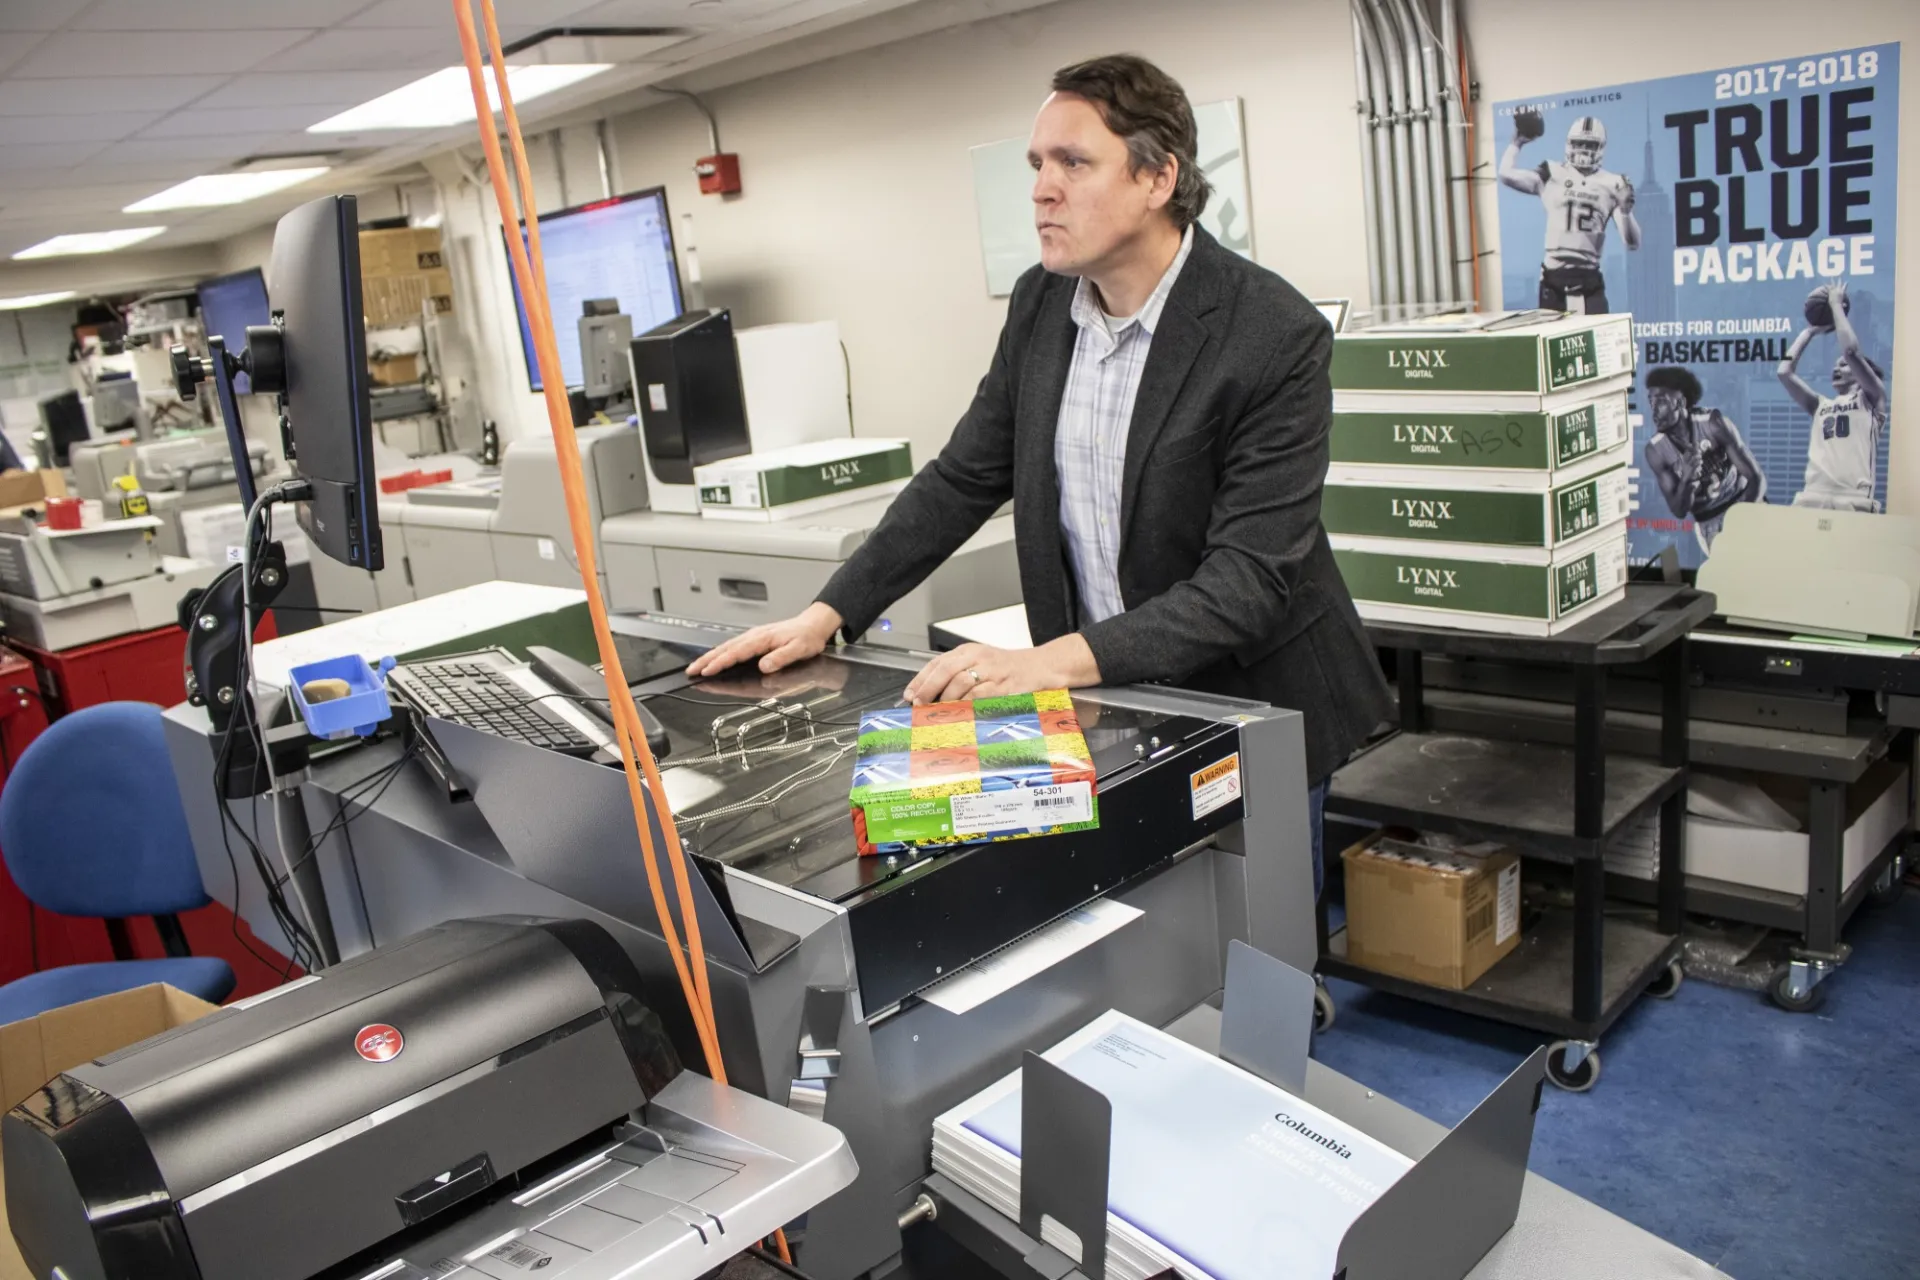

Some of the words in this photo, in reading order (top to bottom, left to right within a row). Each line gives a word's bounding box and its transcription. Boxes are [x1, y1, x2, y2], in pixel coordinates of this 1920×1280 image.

[1715, 51, 1878, 99] 2017-2018
[1498, 101, 1556, 116] COLUMBIA
[1563, 92, 1622, 108] ATHLETICS
[1664, 86, 1874, 178] TRUE
[1674, 162, 1873, 247] BLUE
[1563, 200, 1593, 232] 12
[1673, 235, 1875, 285] PACKAGE
[1688, 320, 1712, 336] FOR
[1717, 317, 1791, 335] COLUMBIA
[1560, 335, 1586, 352] LYNX
[1560, 347, 1586, 358] DIGITAL
[1645, 338, 1793, 364] BASKETBALL
[1388, 349, 1448, 368] LYNX
[1405, 369, 1434, 378] DIGITAL
[1566, 410, 1588, 428] LYNX
[1823, 415, 1850, 440] 20
[1393, 425, 1456, 444] LYNX
[1411, 443, 1441, 454] DIGITAL
[821, 460, 861, 481] LYNX
[1568, 486, 1590, 505] LYNX
[1391, 499, 1453, 519] LYNX
[1408, 518, 1438, 529] DIGITAL
[1397, 566, 1459, 588] LYNX
[1566, 558, 1588, 579] LYNX
[1414, 586, 1444, 597] DIGITAL
[1205, 760, 1235, 782] WARNING
[1033, 786, 1062, 796] 54-301
[891, 803, 915, 813] COLOR
[917, 802, 936, 810] COPY
[910, 808, 946, 817] RECYCLED
[360, 1030, 396, 1053] GBC
[1274, 1112, 1353, 1160] Columbia
